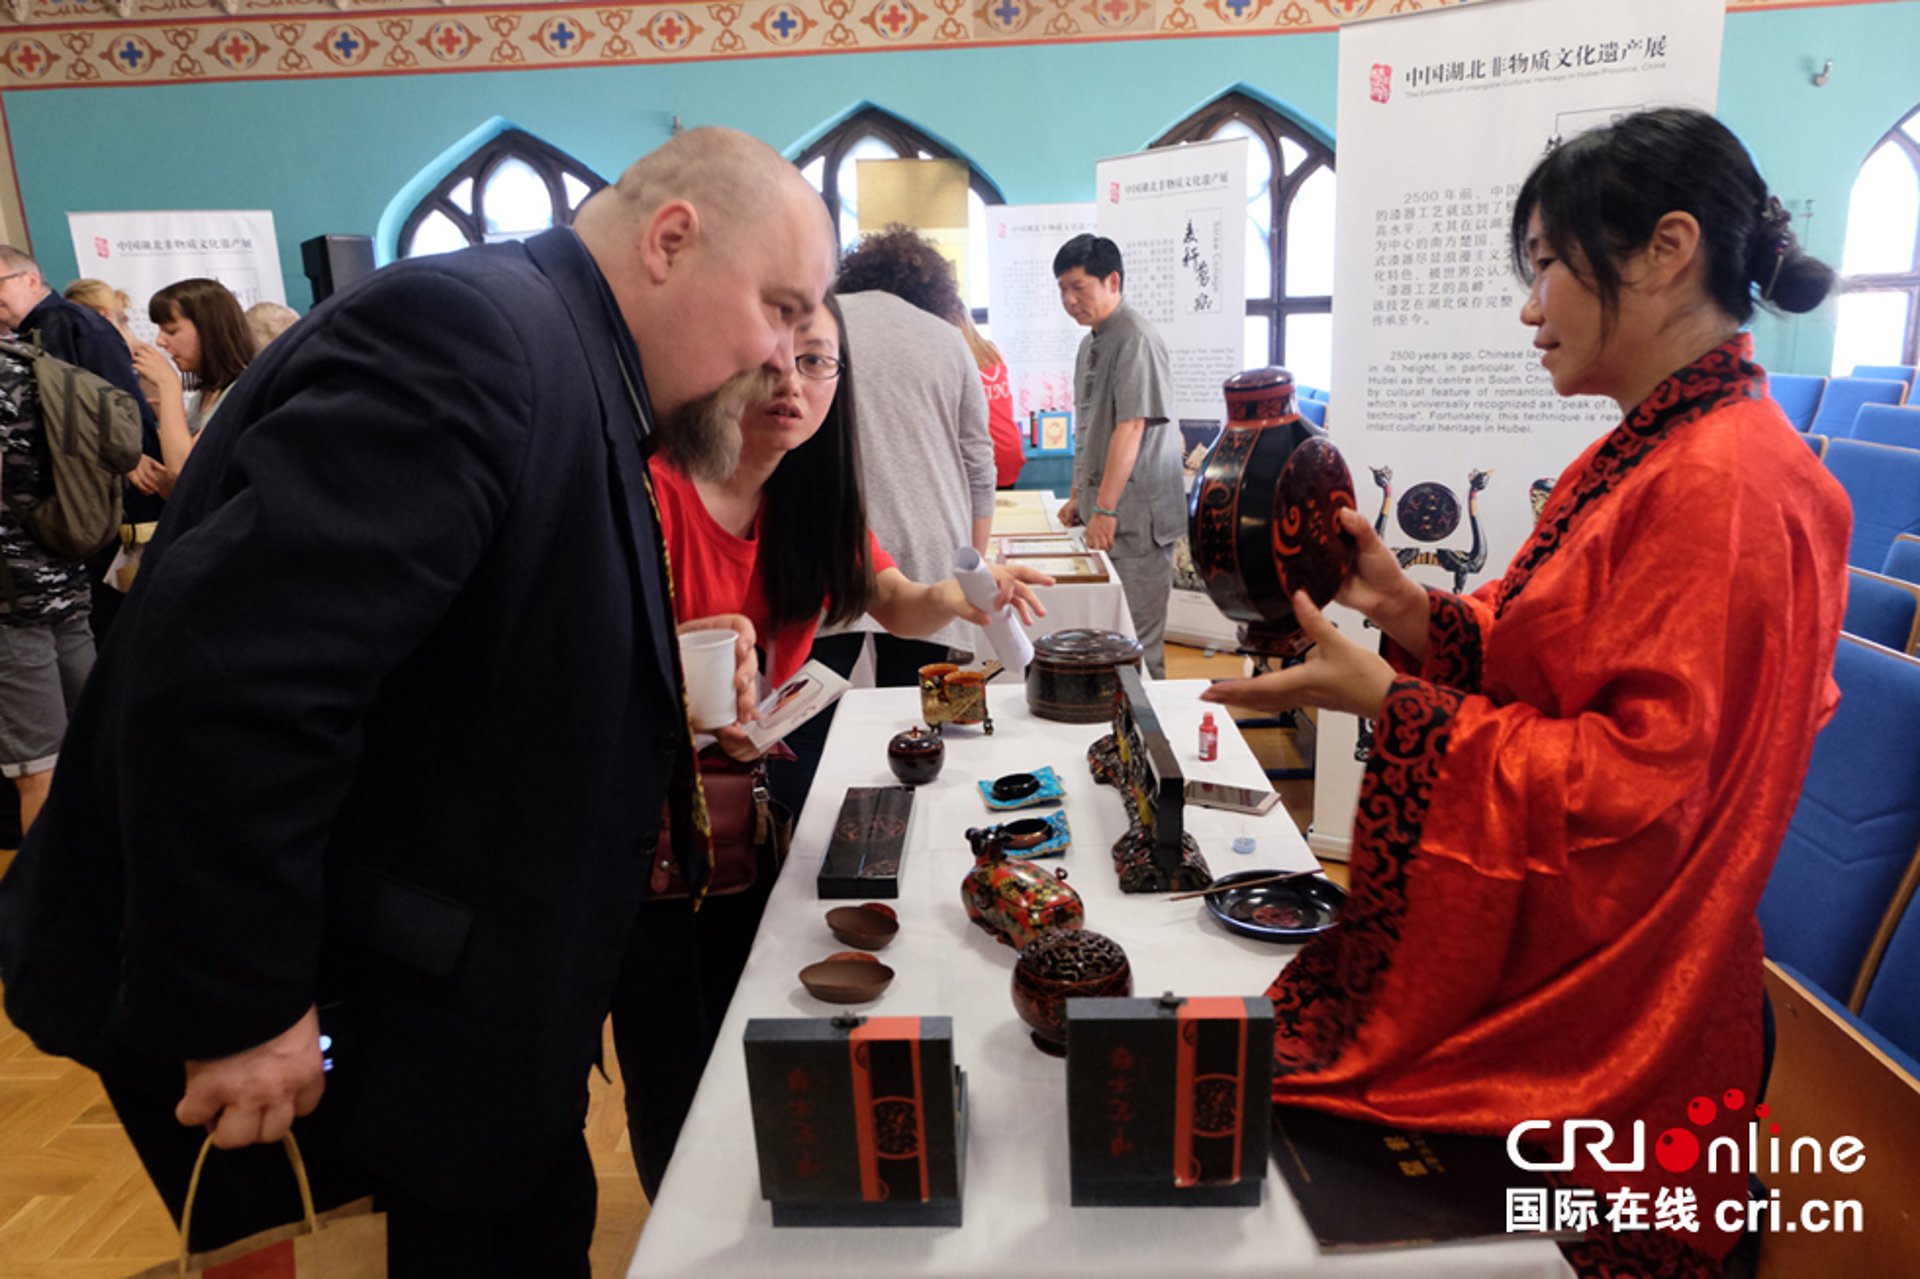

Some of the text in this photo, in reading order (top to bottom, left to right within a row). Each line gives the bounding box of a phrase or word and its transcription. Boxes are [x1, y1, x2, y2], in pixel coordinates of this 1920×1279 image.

[1404, 34, 1668, 88] 中国湖北非物质文化遗产展
[1641, 60, 1667, 71] China
[1390, 350, 1416, 361] 2500
[1418, 352, 1448, 363] years
[1478, 349, 1523, 360] Chinese
[1368, 364, 1378, 373] in
[1384, 364, 1396, 373] its
[1445, 364, 1456, 372] in
[1368, 376, 1398, 385] Hubei
[1401, 377, 1413, 385] as
[1416, 376, 1433, 385] the
[1437, 376, 1472, 385] centre
[1475, 376, 1485, 384] in
[1488, 375, 1521, 385] South
[1367, 387, 1555, 398] by cultural feature of romanticis
[1367, 399, 1396, 408] which
[1399, 399, 1408, 408] is
[1411, 399, 1470, 410] universally
[1473, 399, 1536, 410] recognized
[1539, 400, 1553, 409] as
[1594, 399, 1606, 409] of
[1498, 412, 1519, 421] this
[1523, 412, 1581, 423] technique
[1585, 412, 1595, 421] is
[1366, 423, 1534, 435] intact cultural heritage in Hubei.
